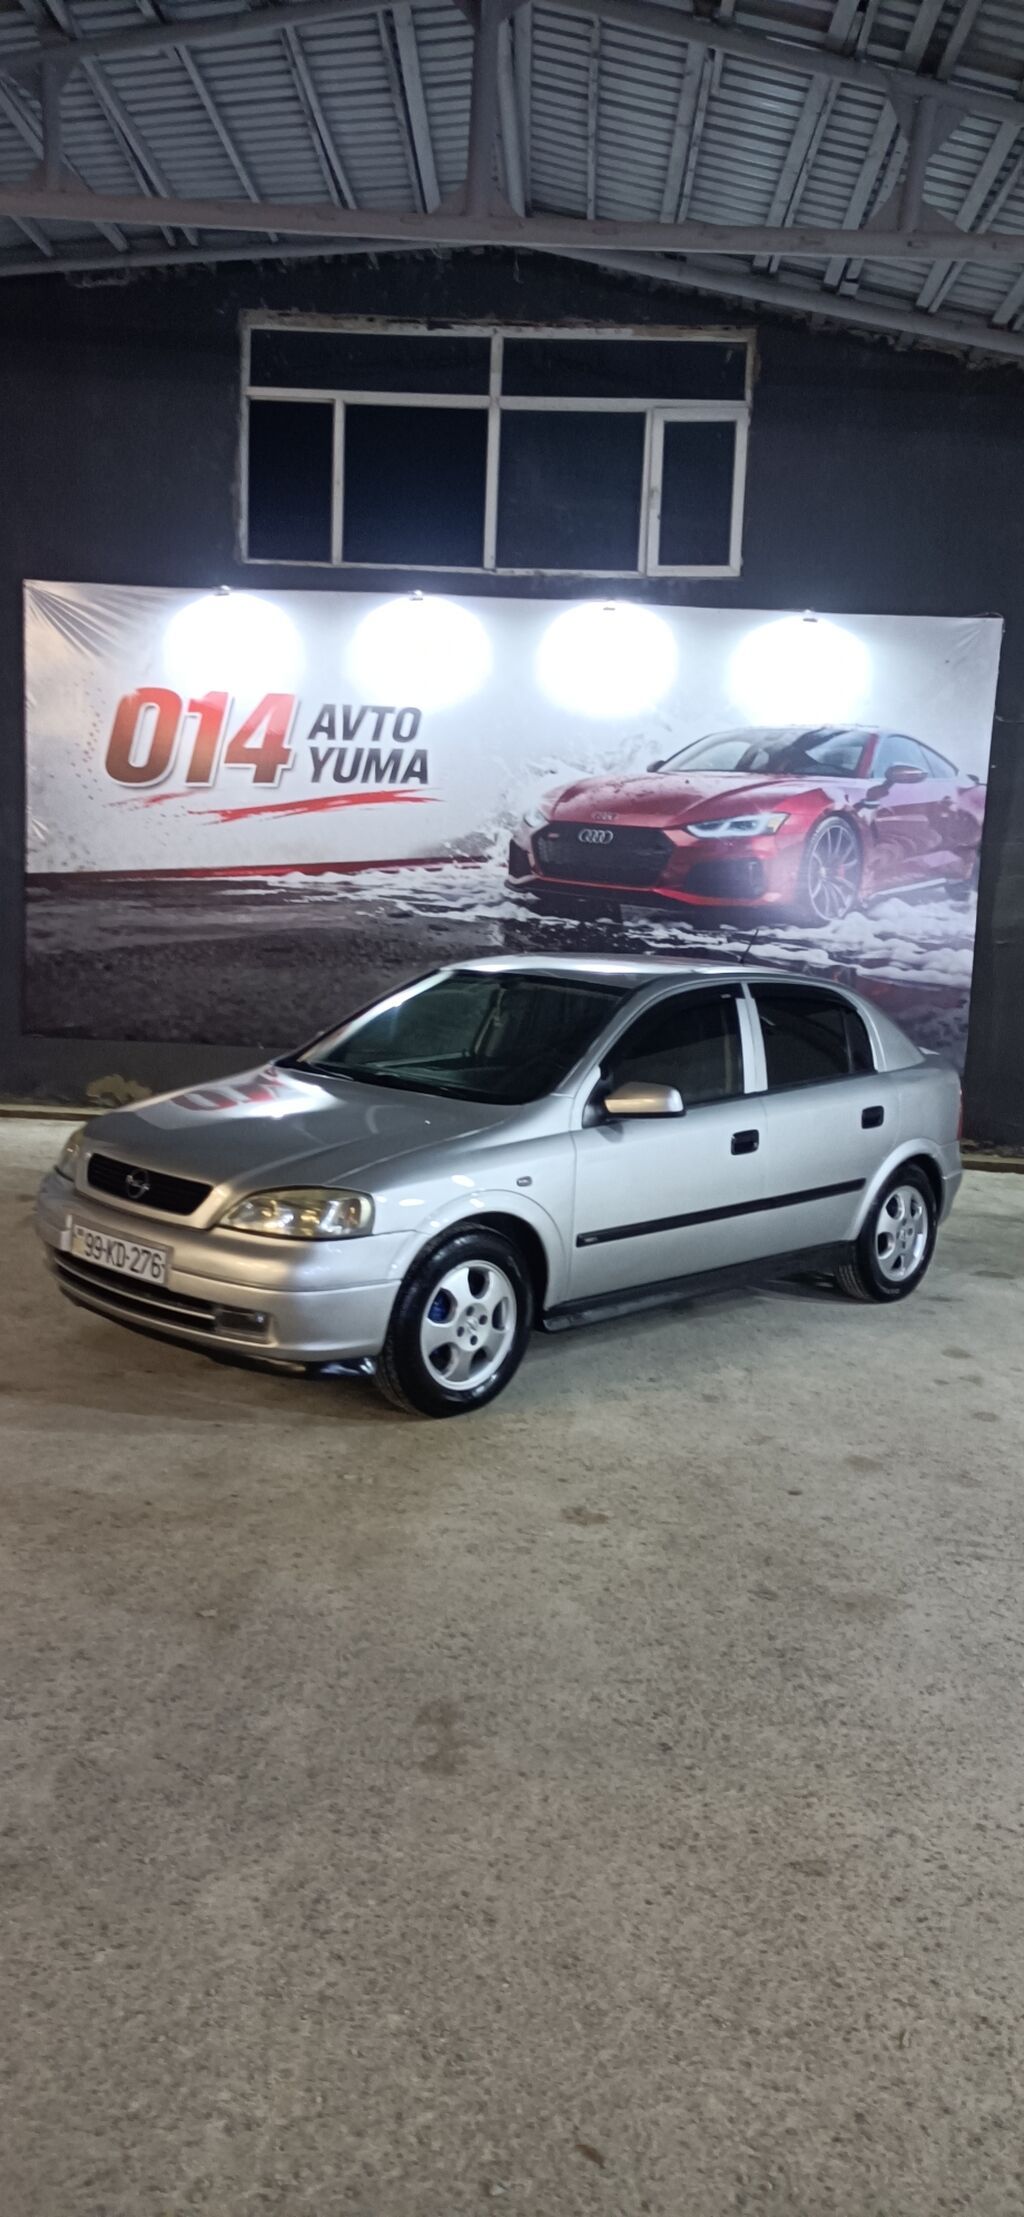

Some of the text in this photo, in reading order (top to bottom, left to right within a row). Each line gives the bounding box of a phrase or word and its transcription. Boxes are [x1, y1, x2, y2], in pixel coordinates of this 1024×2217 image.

[105, 687, 295, 784] 014
[308, 703, 422, 742] AVTO
[311, 746, 428, 784] YUMA
[84, 1232, 161, 1279] 99-KD-276
